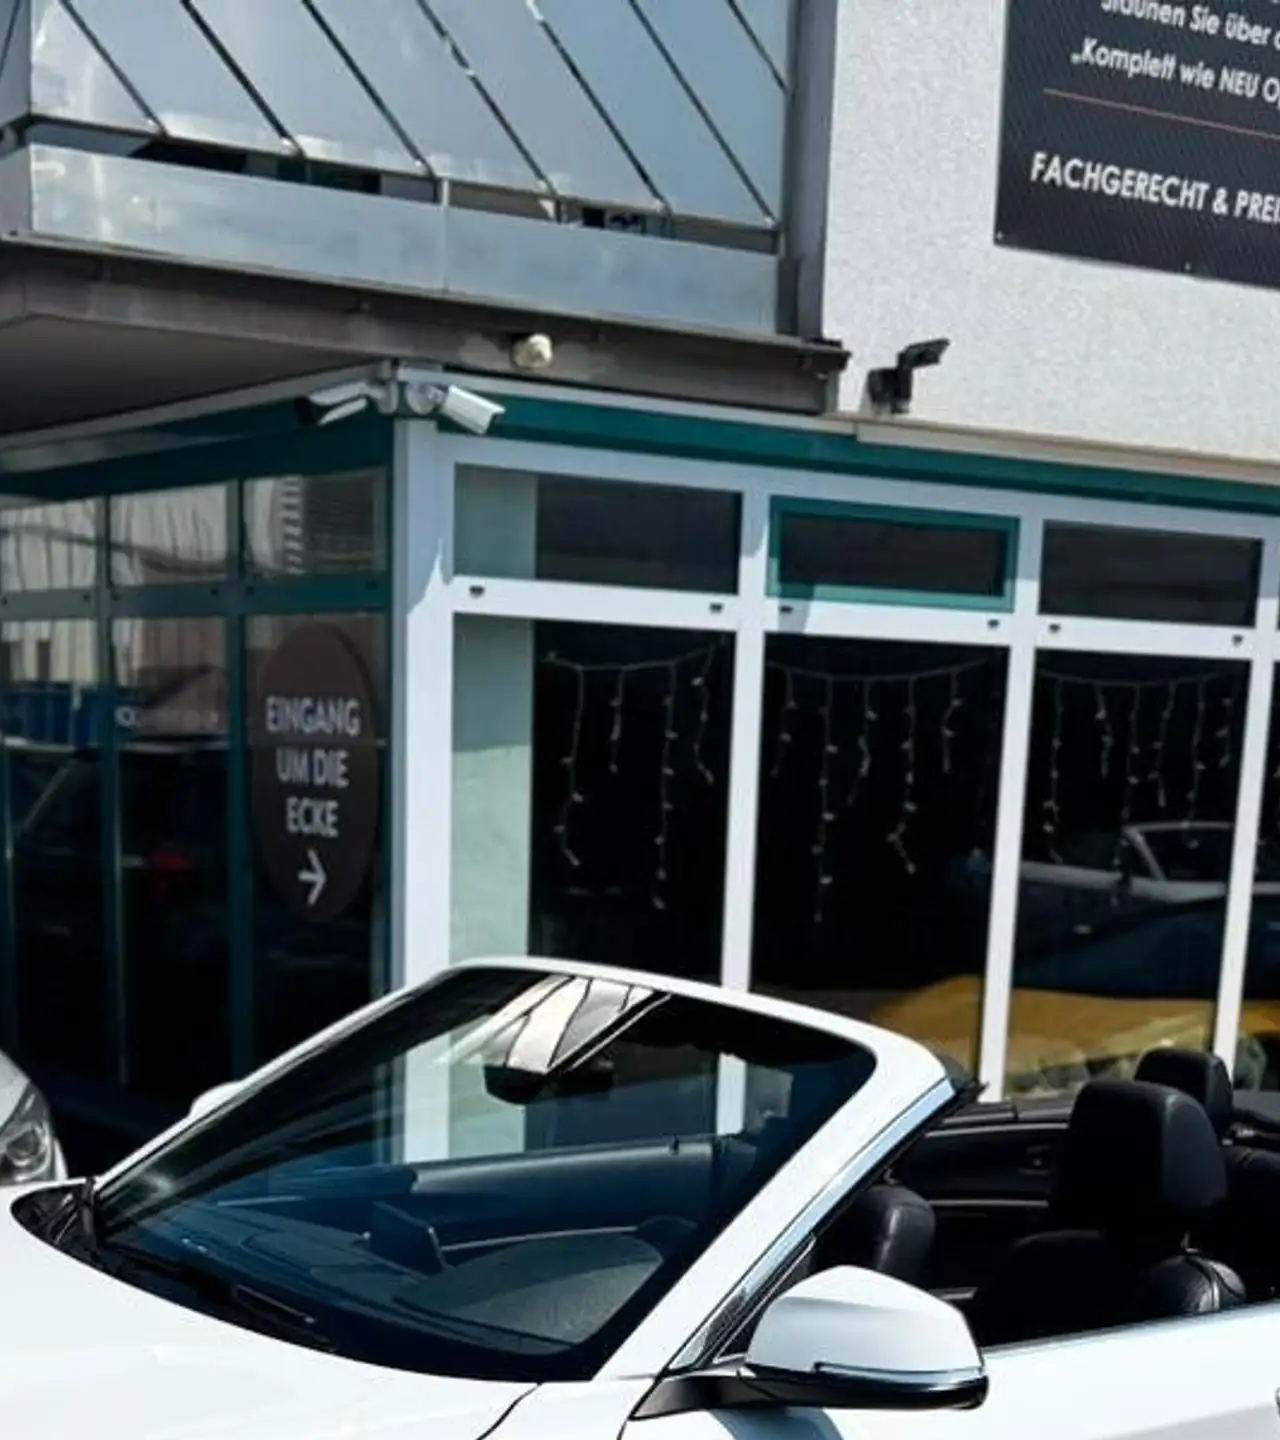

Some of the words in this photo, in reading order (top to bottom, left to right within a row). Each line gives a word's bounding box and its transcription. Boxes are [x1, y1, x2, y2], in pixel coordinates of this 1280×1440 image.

[1189, 4, 1220, 35] Sie
[1225, 12, 1271, 45] über
[1180, 60, 1215, 89] wie
[1220, 65, 1261, 98] NEU
[1030, 151, 1210, 211] FACHGERECHT
[1212, 187, 1228, 215] &
[265, 697, 361, 737] EINGANG
[276, 747, 309, 785] UM
[313, 748, 349, 788] DIE
[286, 797, 340, 838] ECKE
